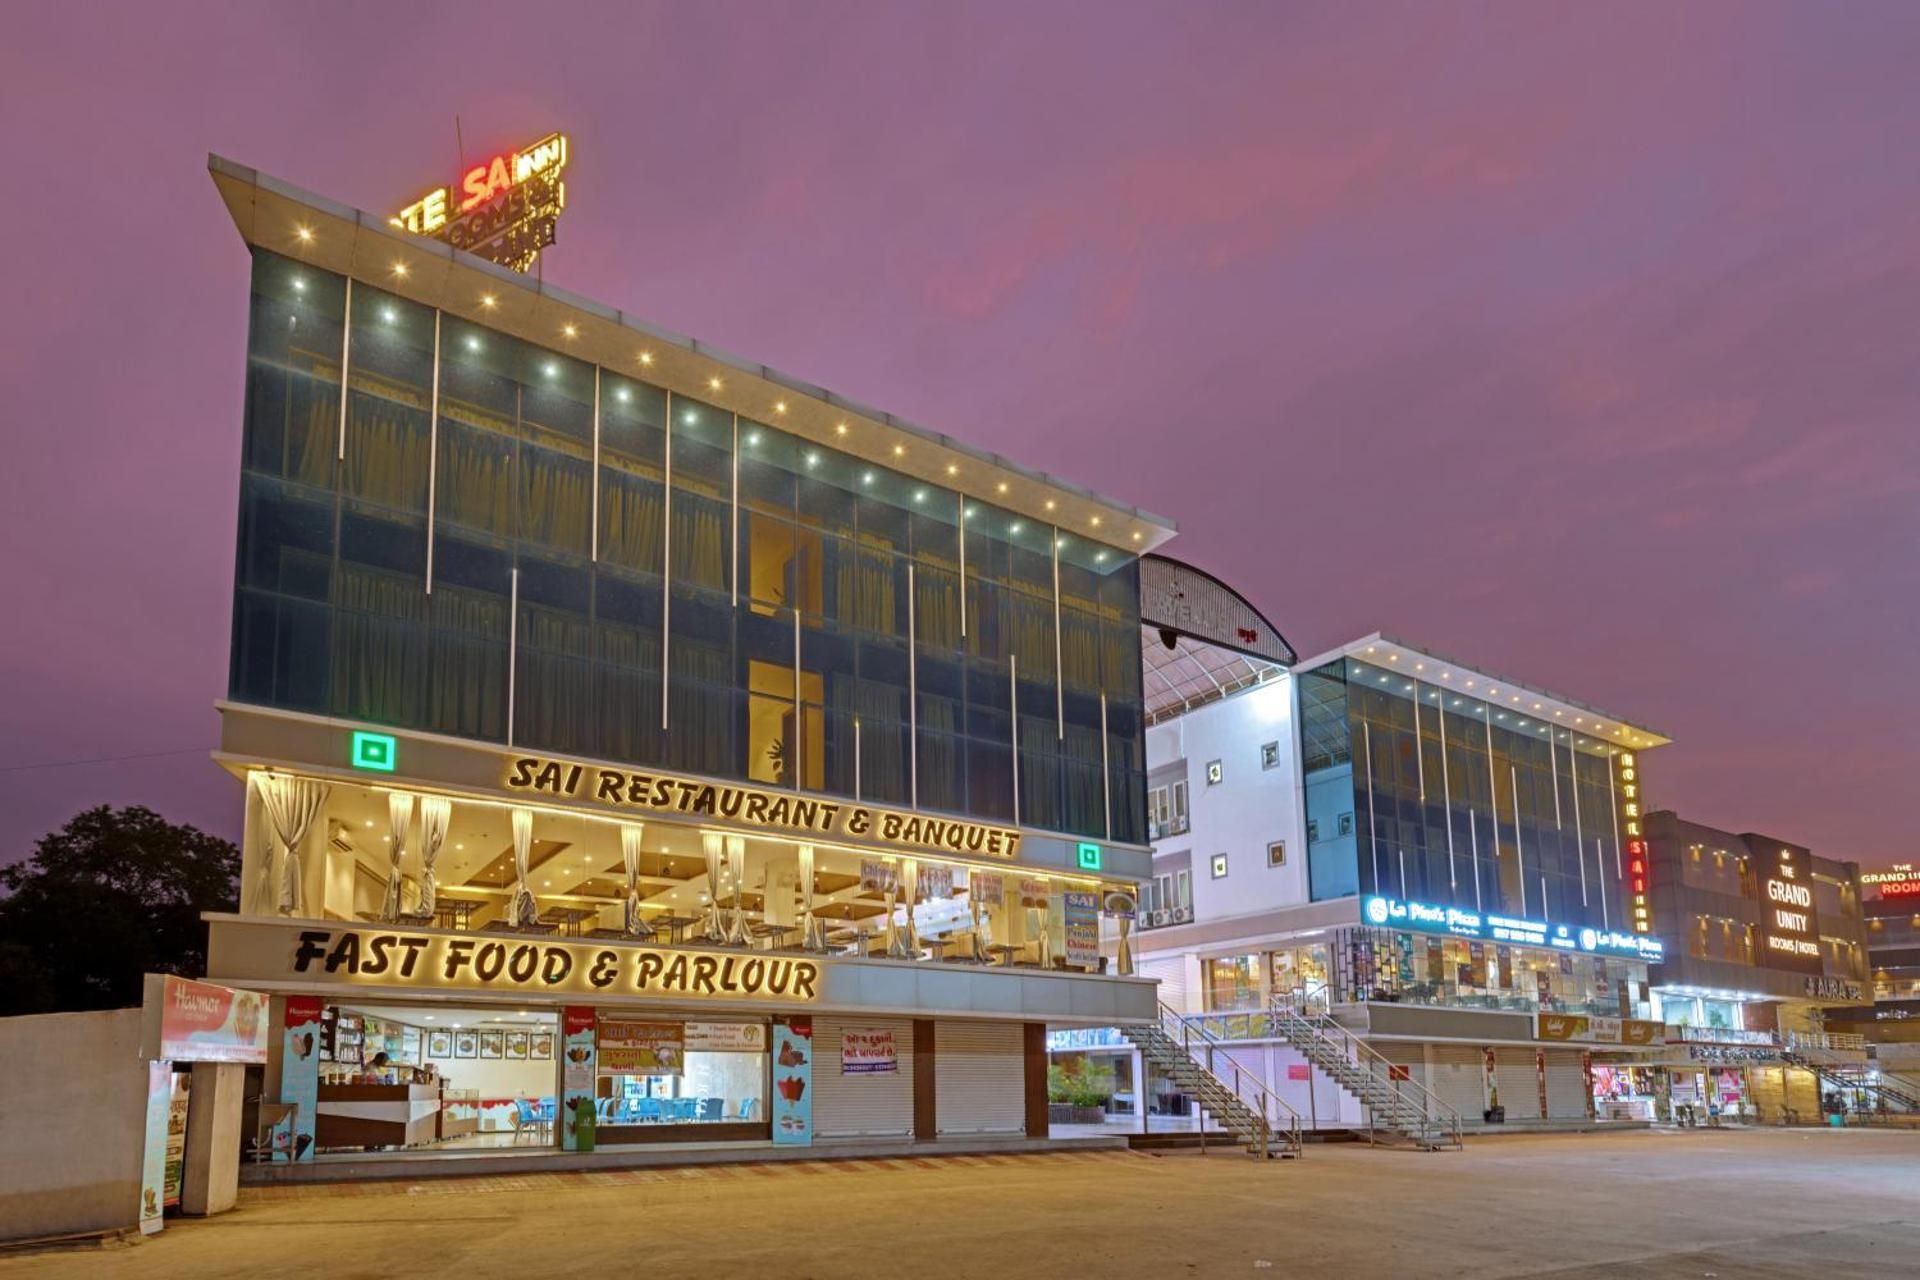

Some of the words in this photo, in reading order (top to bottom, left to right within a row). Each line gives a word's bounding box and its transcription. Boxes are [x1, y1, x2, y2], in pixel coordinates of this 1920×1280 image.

[462, 153, 518, 212] SAI
[517, 138, 559, 183] INN
[508, 759, 583, 794] SAI
[598, 771, 838, 831] RESTAURANT
[849, 809, 870, 834] &
[882, 814, 1020, 856] BANQUET
[1621, 753, 1640, 836] HOTEL
[1630, 841, 1643, 890] SAI
[1780, 864, 1794, 878] THE
[1861, 873, 1905, 882] GRAND
[1768, 880, 1810, 907] GRAND
[1635, 895, 1648, 932] INN
[1776, 909, 1806, 932] UNITY
[1769, 936, 1794, 952] ROOMS
[1799, 941, 1820, 956] HOTEL
[294, 931, 429, 977] FAST
[445, 941, 572, 985] FOOD
[589, 951, 618, 987] &
[636, 953, 817, 998] PARLOUR
[1818, 976, 1846, 1000] AURA
